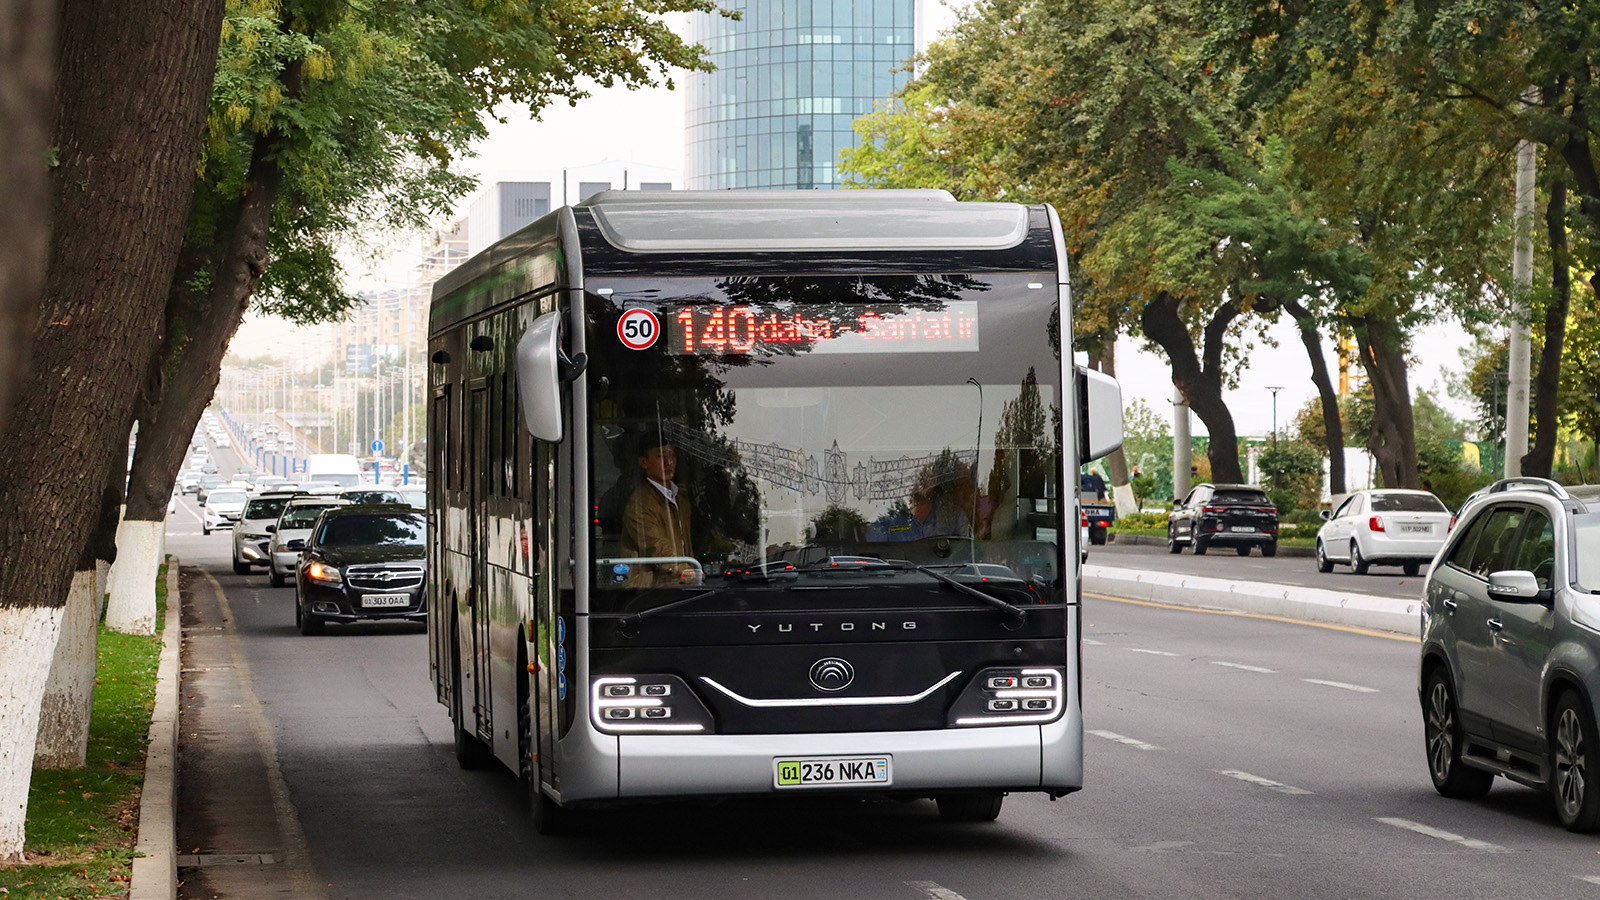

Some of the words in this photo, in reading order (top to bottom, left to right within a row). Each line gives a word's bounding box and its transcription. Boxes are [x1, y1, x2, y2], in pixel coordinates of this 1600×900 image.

[624, 319, 653, 339] 50
[677, 306, 755, 352] 140
[372, 597, 387, 605] 303
[747, 621, 917, 633] YUTONG
[782, 766, 798, 780] 01
[802, 763, 834, 781] 236
[839, 761, 876, 780] NKA
